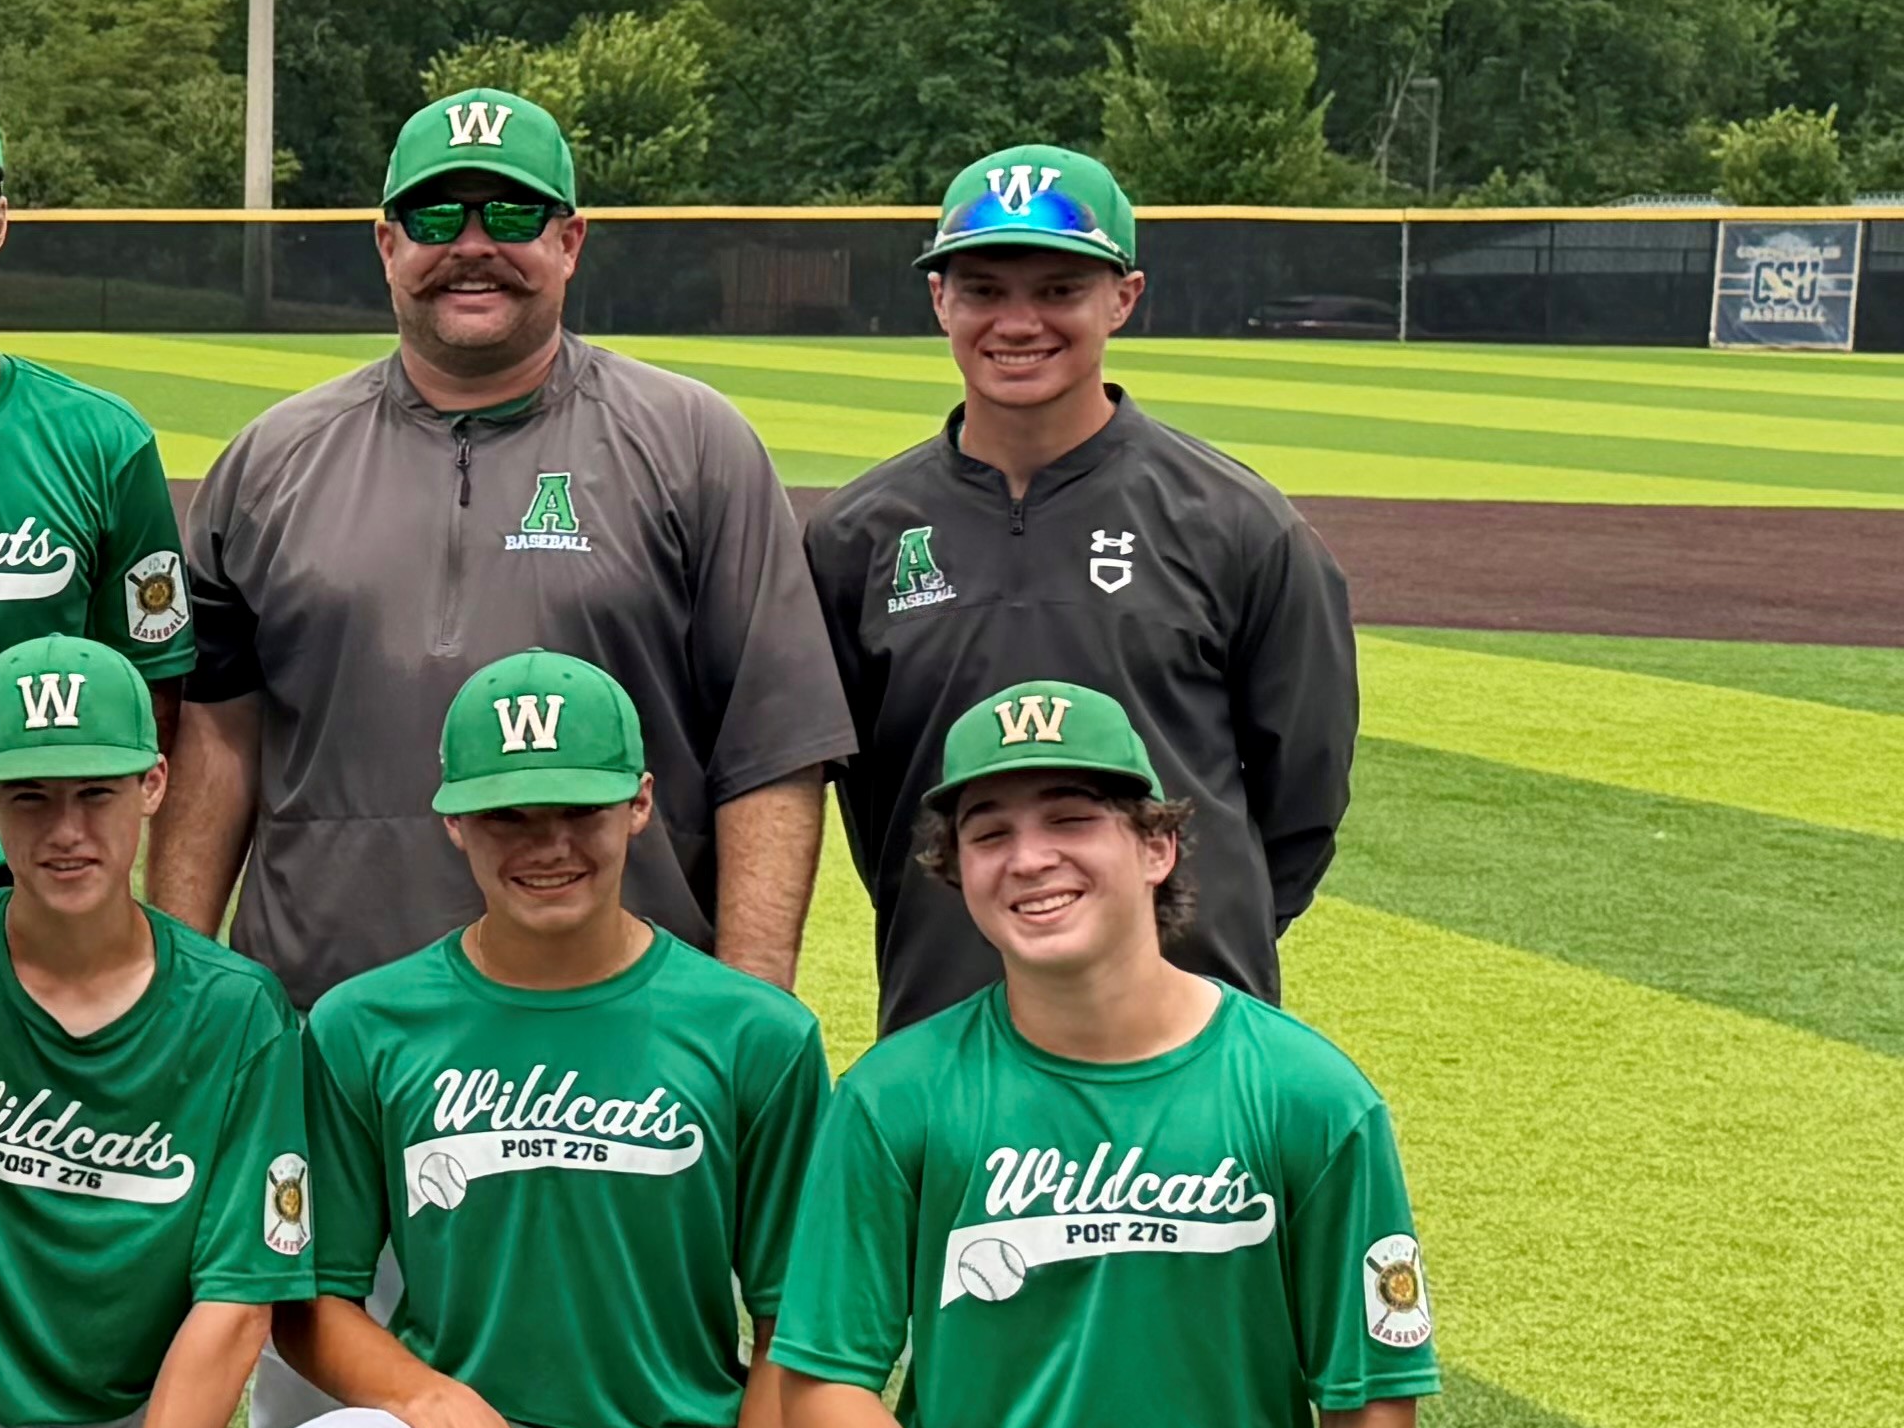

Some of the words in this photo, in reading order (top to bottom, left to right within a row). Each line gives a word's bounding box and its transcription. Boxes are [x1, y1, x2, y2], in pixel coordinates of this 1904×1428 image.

[444, 101, 513, 147] W
[986, 164, 1062, 217] W
[1752, 261, 1821, 306] CSU
[1740, 306, 1827, 323] BASEBALL
[521, 472, 580, 532] A
[505, 534, 592, 552] BASEBALL
[892, 525, 938, 596] A
[887, 584, 957, 614] BASEBALL
[15, 672, 87, 730] W
[493, 693, 566, 752] W
[994, 694, 1073, 746] W
[432, 1065, 684, 1142] Wildcats
[501, 1139, 557, 1160] POST
[562, 1141, 609, 1163] 276
[56, 1166, 103, 1190] 276
[984, 1141, 1258, 1216] Wildcats
[1127, 1222, 1179, 1244] 276
